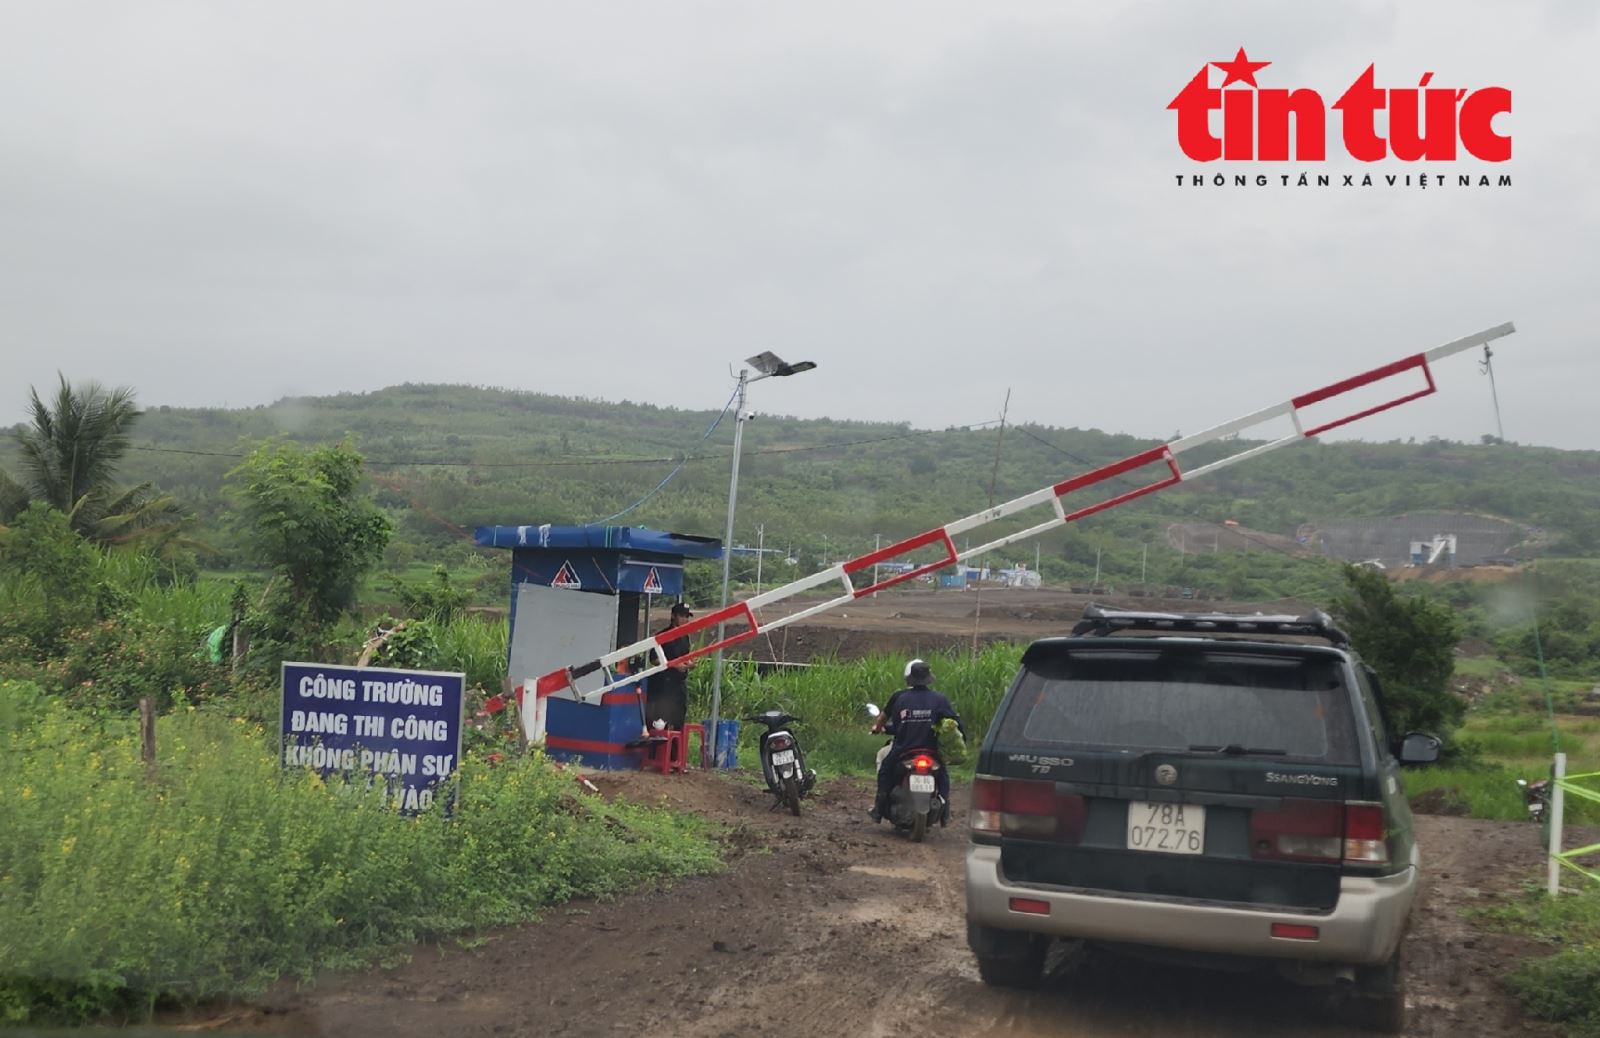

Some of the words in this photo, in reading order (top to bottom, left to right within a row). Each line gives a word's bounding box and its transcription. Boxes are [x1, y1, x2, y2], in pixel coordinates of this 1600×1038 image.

[299, 673, 356, 701] CÔNG
[362, 678, 443, 707] TRƯỜNG
[291, 710, 348, 735] ĐANG
[353, 715, 385, 738] THI
[390, 714, 448, 742] CÔNG
[286, 742, 354, 769] KHÔNG
[1008, 754, 1074, 767] MUSSO
[1147, 802, 1185, 826] 78A
[1131, 825, 1201, 851] 072.76
